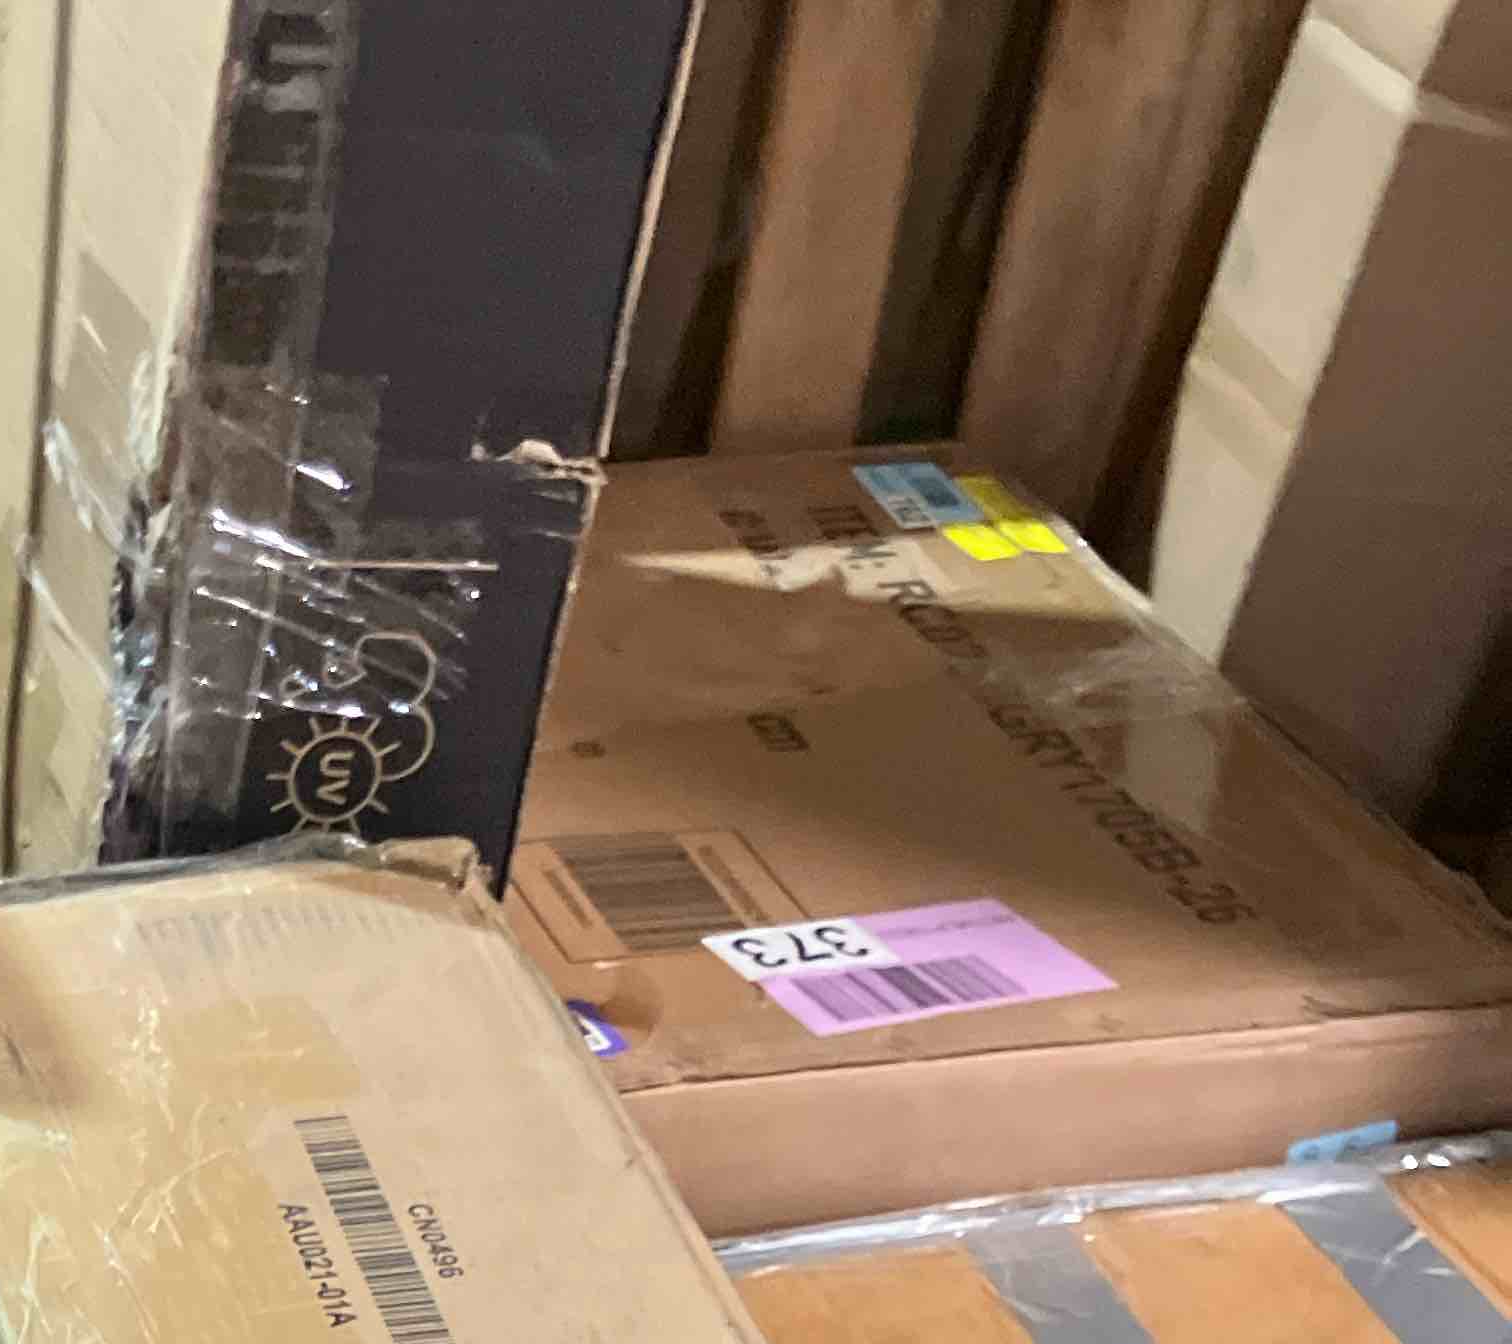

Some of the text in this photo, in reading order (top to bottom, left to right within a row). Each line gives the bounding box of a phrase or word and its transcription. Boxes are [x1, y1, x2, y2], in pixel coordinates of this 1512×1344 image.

[316, 751, 356, 805] UV
[732, 928, 869, 968] 373
[277, 1201, 359, 1329] AAU021-01A
[408, 1202, 465, 1279] CN0496
